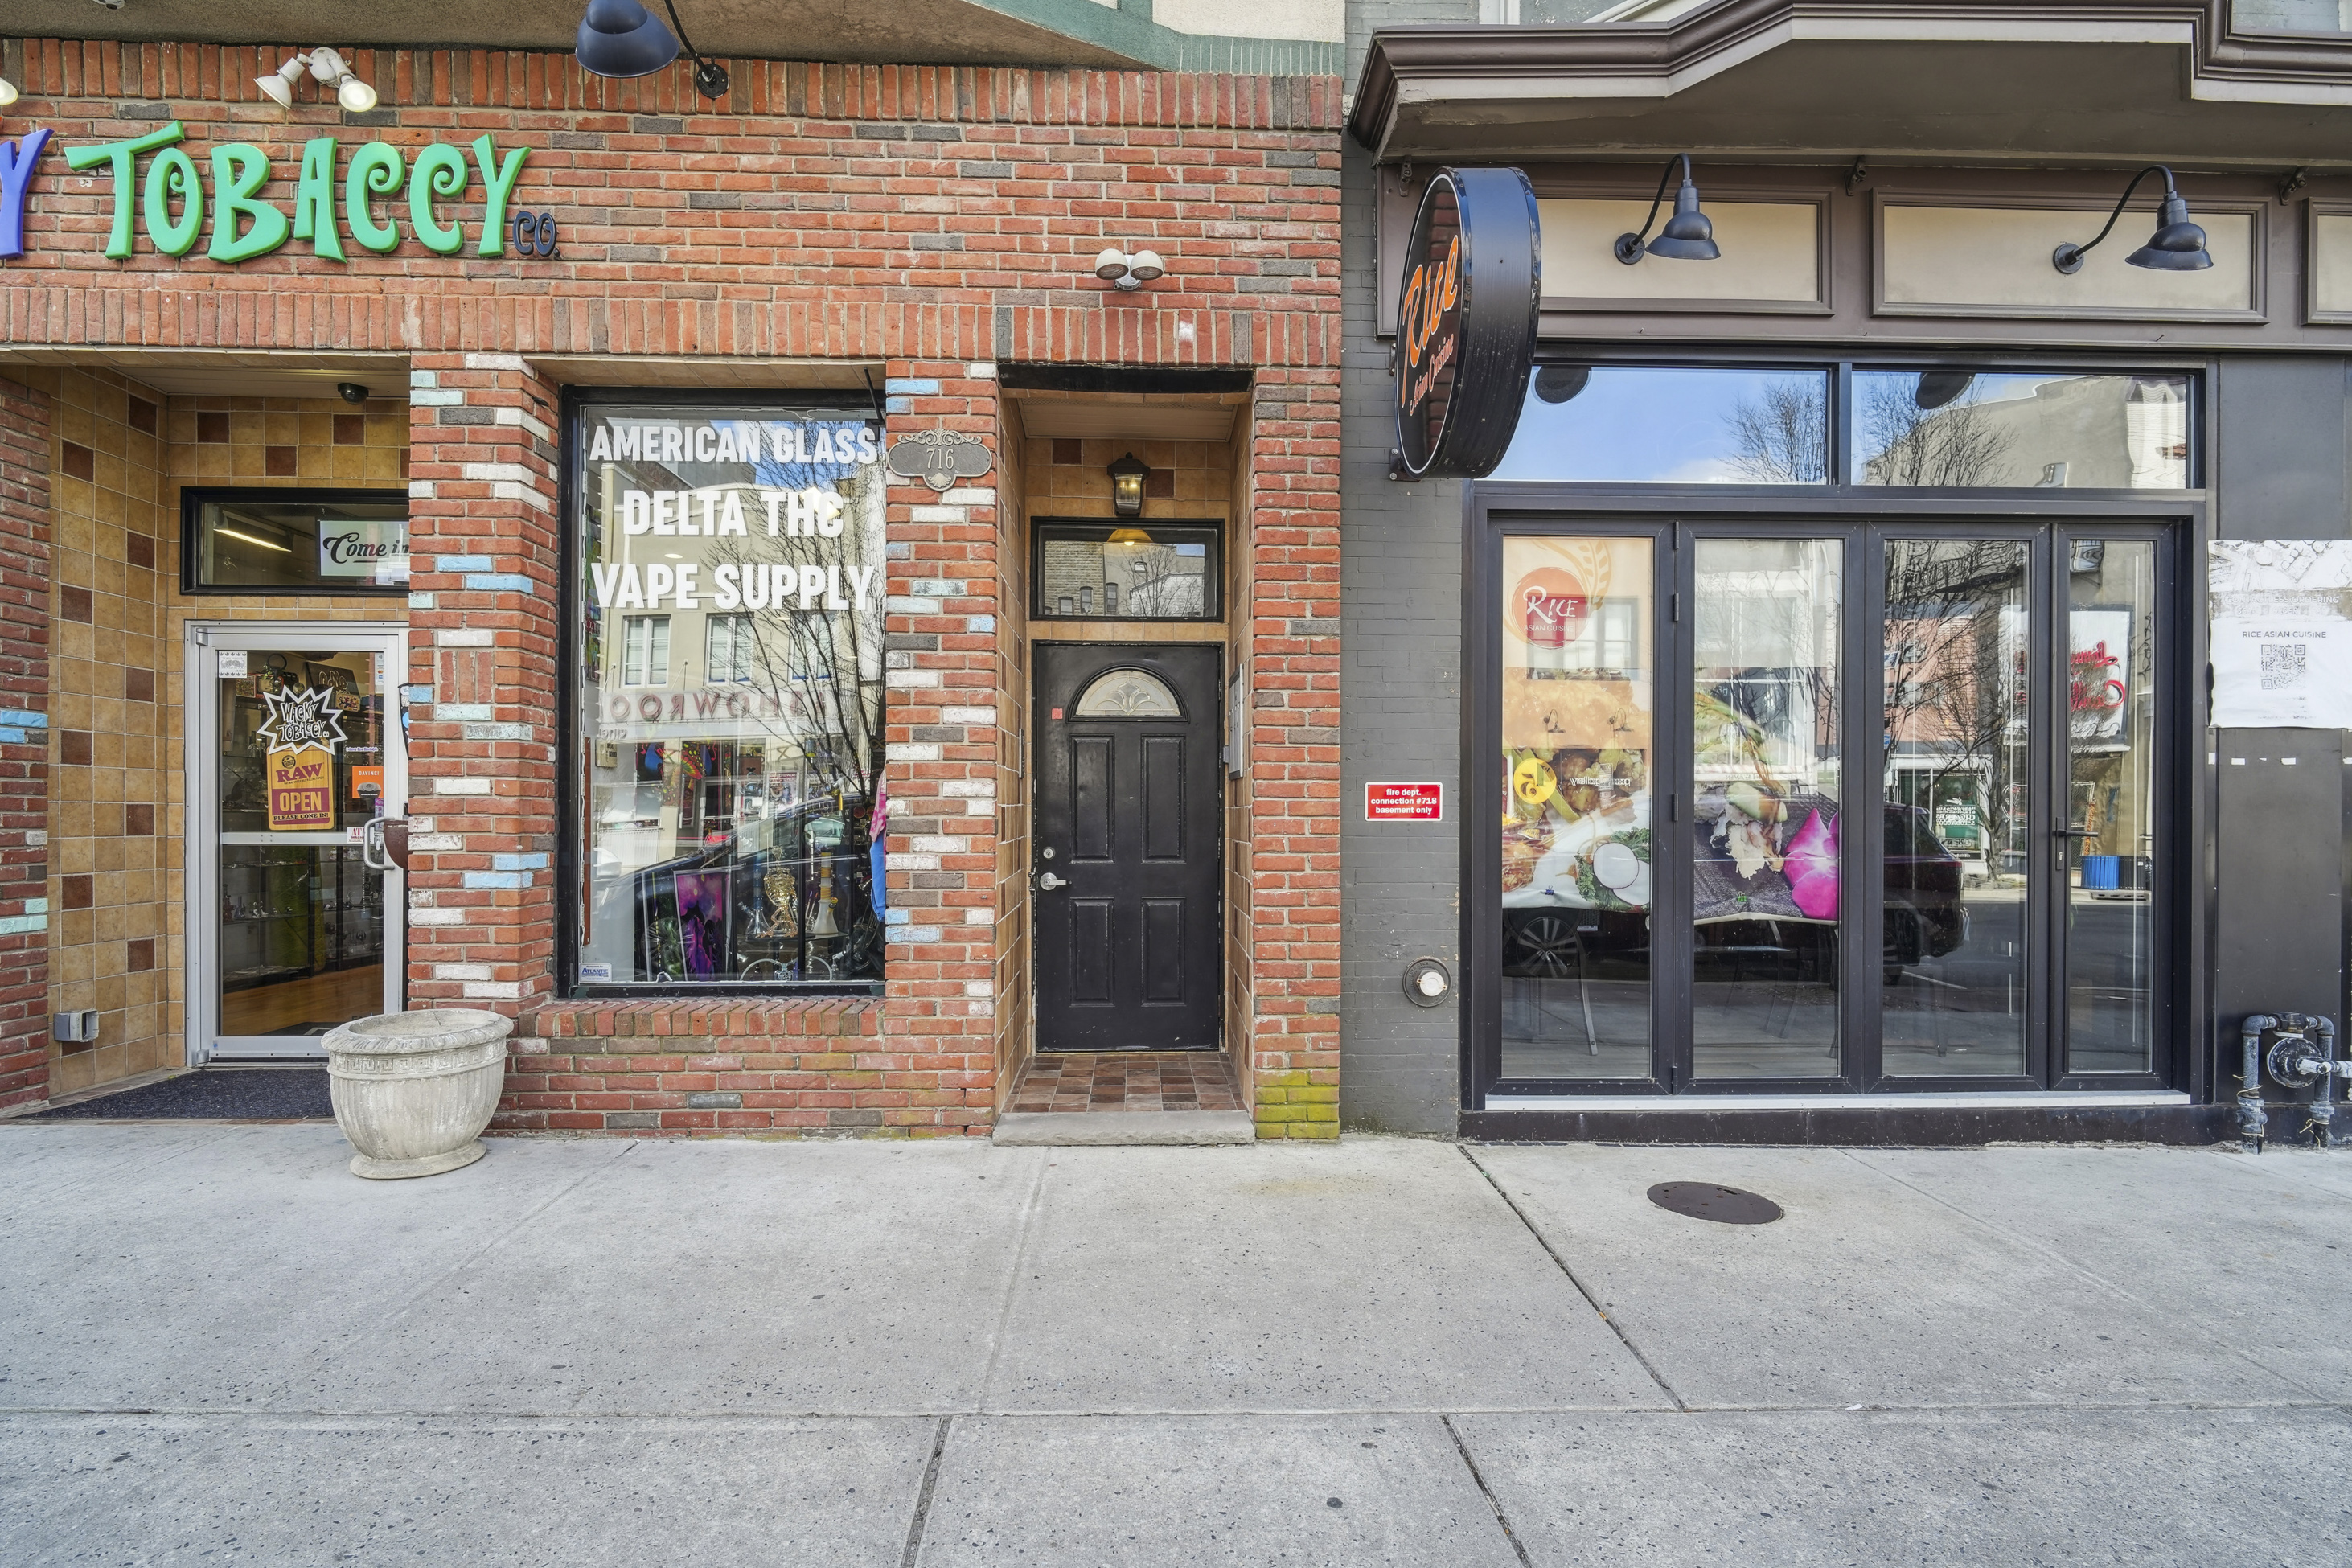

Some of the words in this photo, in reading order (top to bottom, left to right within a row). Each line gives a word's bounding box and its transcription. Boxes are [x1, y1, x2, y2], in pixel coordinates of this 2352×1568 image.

[64, 121, 532, 264] TOBACCY
[1402, 235, 1459, 408] Rice
[1410, 371, 1429, 417] Asian
[1430, 334, 1454, 392] Cuisine
[589, 425, 761, 462] AMERICAN
[774, 427, 878, 465] GLASS
[926, 448, 954, 470] 716
[623, 490, 748, 536] DELTA
[761, 491, 844, 538] THC
[322, 532, 388, 564] Come
[591, 563, 699, 610] VAPE
[714, 564, 876, 610] SUPPLY
[2292, 596, 2339, 604] ORDERING
[2242, 630, 2262, 638] RICE
[2264, 630, 2290, 638] ASIAN
[2292, 630, 2327, 638] CUISINE
[280, 700, 318, 723] WACKY
[276, 720, 327, 741] TOBACCY
[276, 762, 324, 783] RAW
[279, 791, 322, 812] OPEN
[1402, 789, 1422, 797] dept.
[1416, 807, 1433, 815] only
